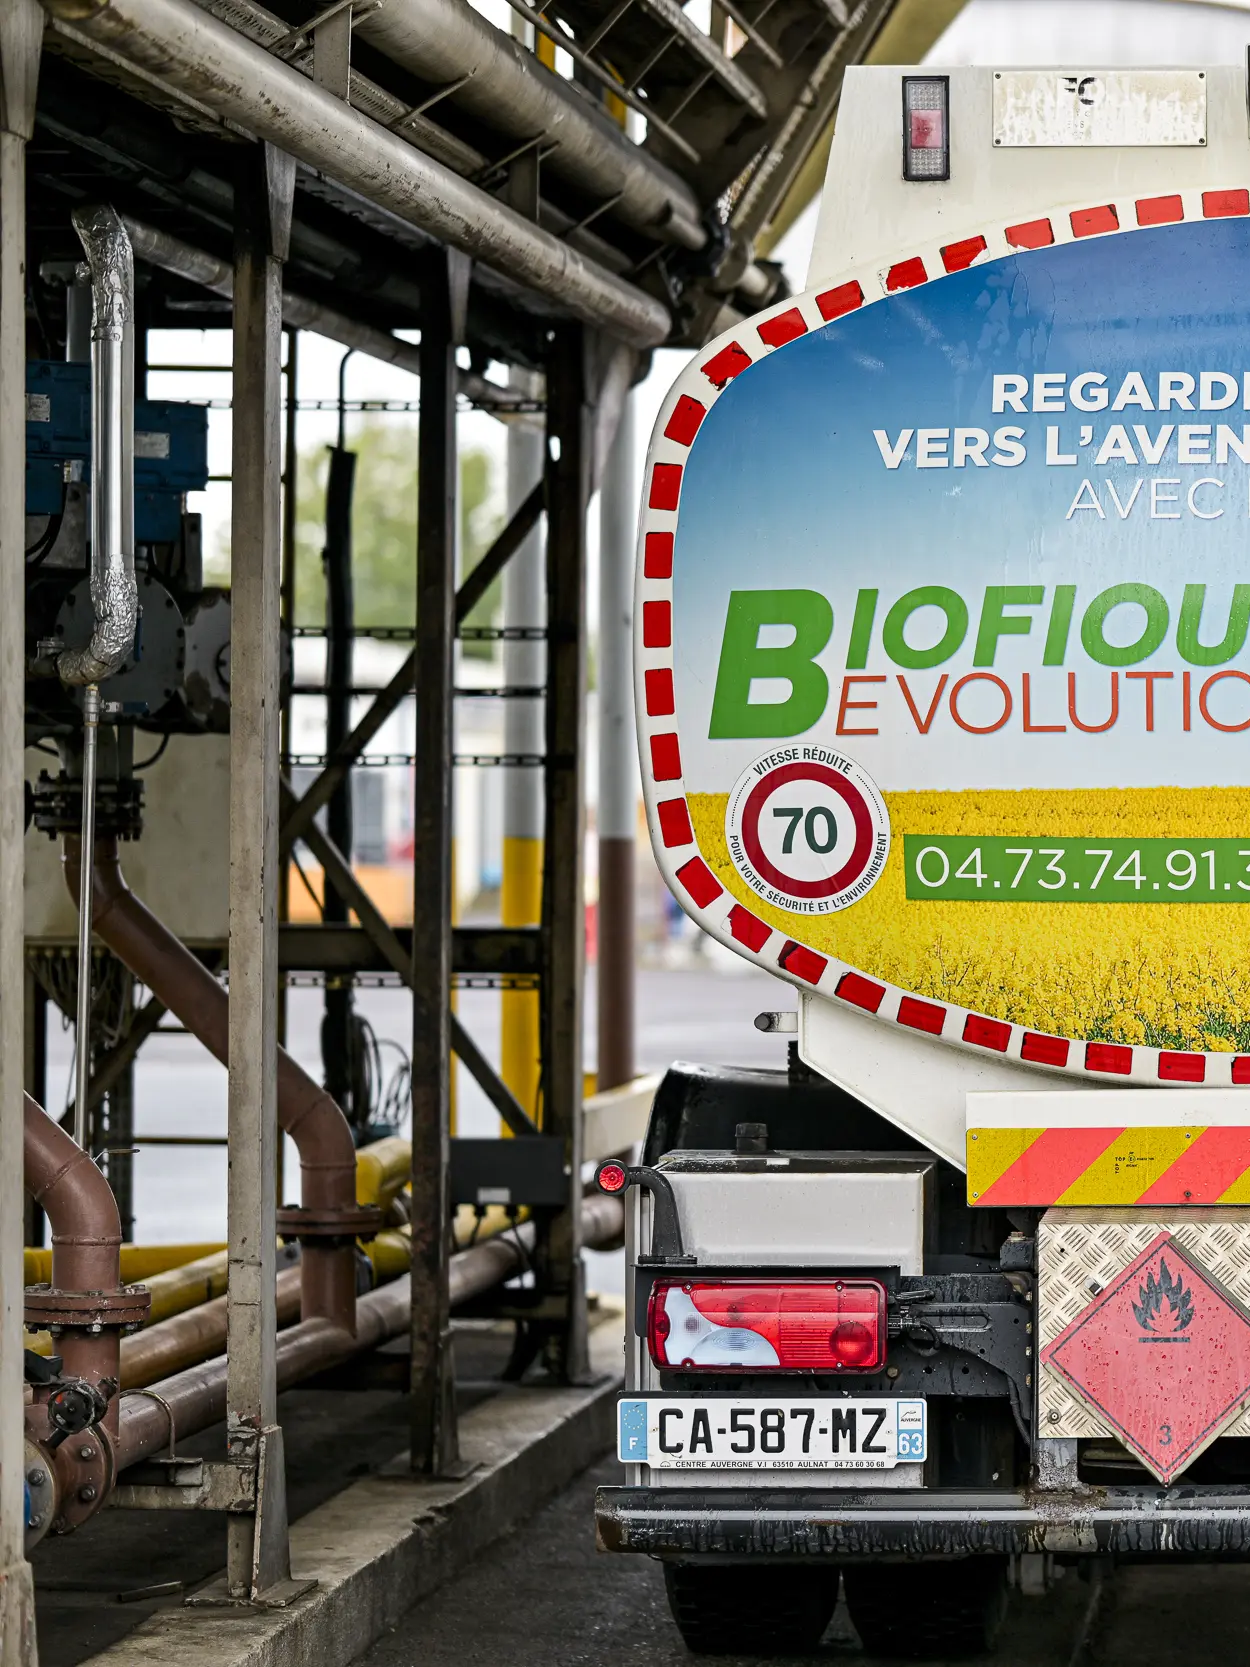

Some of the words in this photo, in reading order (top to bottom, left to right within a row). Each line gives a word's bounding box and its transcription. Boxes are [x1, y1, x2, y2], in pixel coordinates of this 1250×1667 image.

[873, 427, 1025, 469] VERS
[1065, 478, 1225, 520] AVEC
[753, 748, 800, 776] VITESSE
[803, 746, 853, 775] RÉDUITE
[773, 806, 838, 854] 70
[729, 834, 744, 864] POUR
[740, 863, 766, 894] VOTRE
[766, 889, 815, 912] SÉCURITÉ
[818, 901, 830, 912] ET
[832, 832, 887, 908] L'ENVIRONNEMENT
[629, 1437, 638, 1450] F
[658, 1407, 887, 1454] CA-587-MZ
[899, 1433, 923, 1455] 63
[1158, 1425, 1173, 1446] 3
